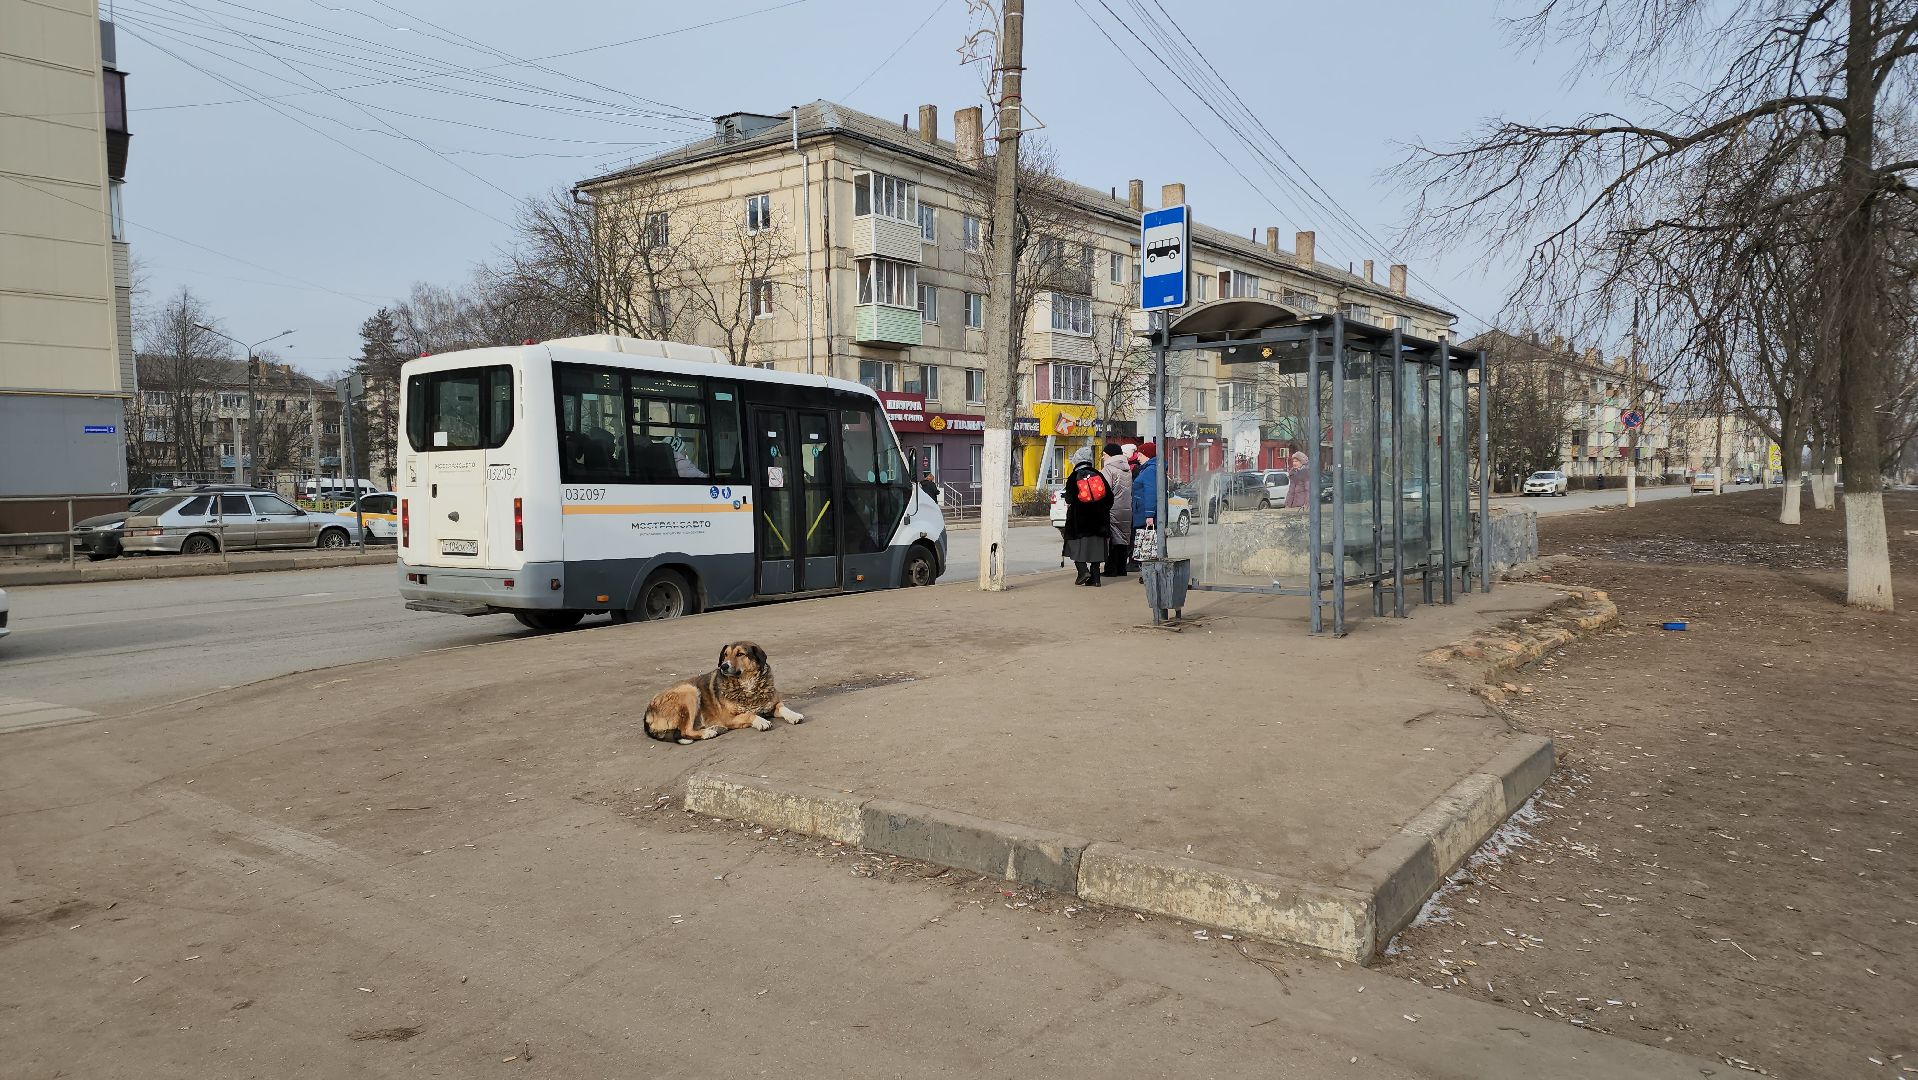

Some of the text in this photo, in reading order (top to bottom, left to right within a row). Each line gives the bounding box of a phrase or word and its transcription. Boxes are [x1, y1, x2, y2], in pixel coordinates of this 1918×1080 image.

[954, 420, 985, 430] ПАЛЫЧ
[487, 467, 518, 481] 032097
[565, 488, 606, 501] 032097
[631, 520, 711, 530] МОСТРАНСАВТО
